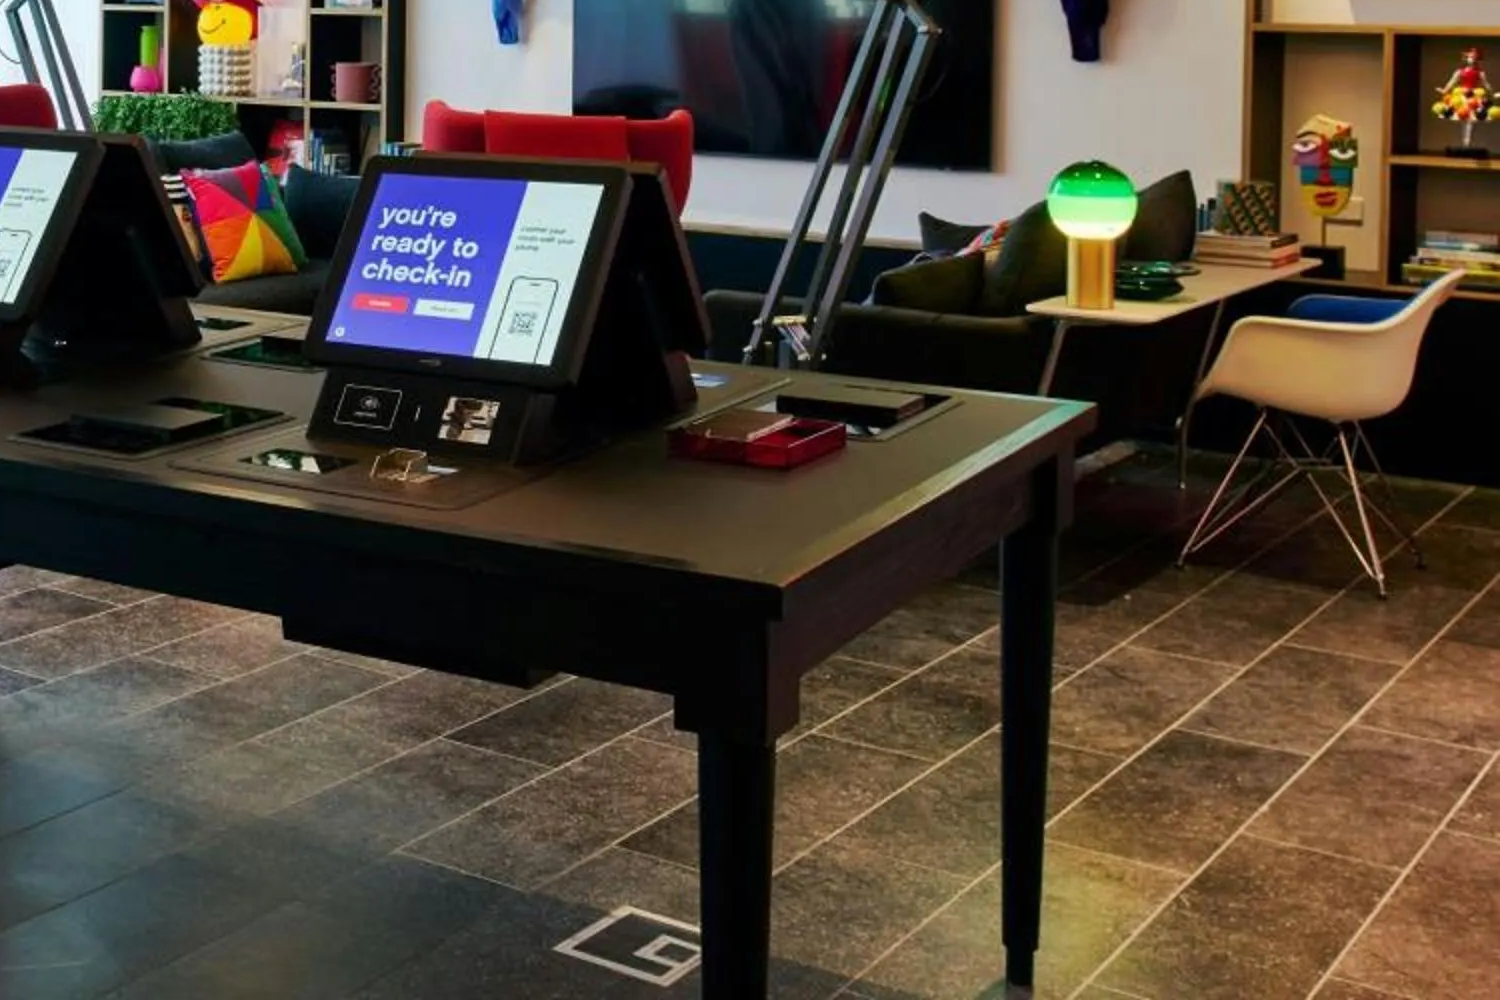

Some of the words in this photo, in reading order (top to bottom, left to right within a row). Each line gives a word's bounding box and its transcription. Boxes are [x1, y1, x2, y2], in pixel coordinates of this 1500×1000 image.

[377, 205, 457, 229] you're
[371, 232, 447, 261] ready
[452, 237, 479, 258] to
[361, 257, 472, 287] check-in
